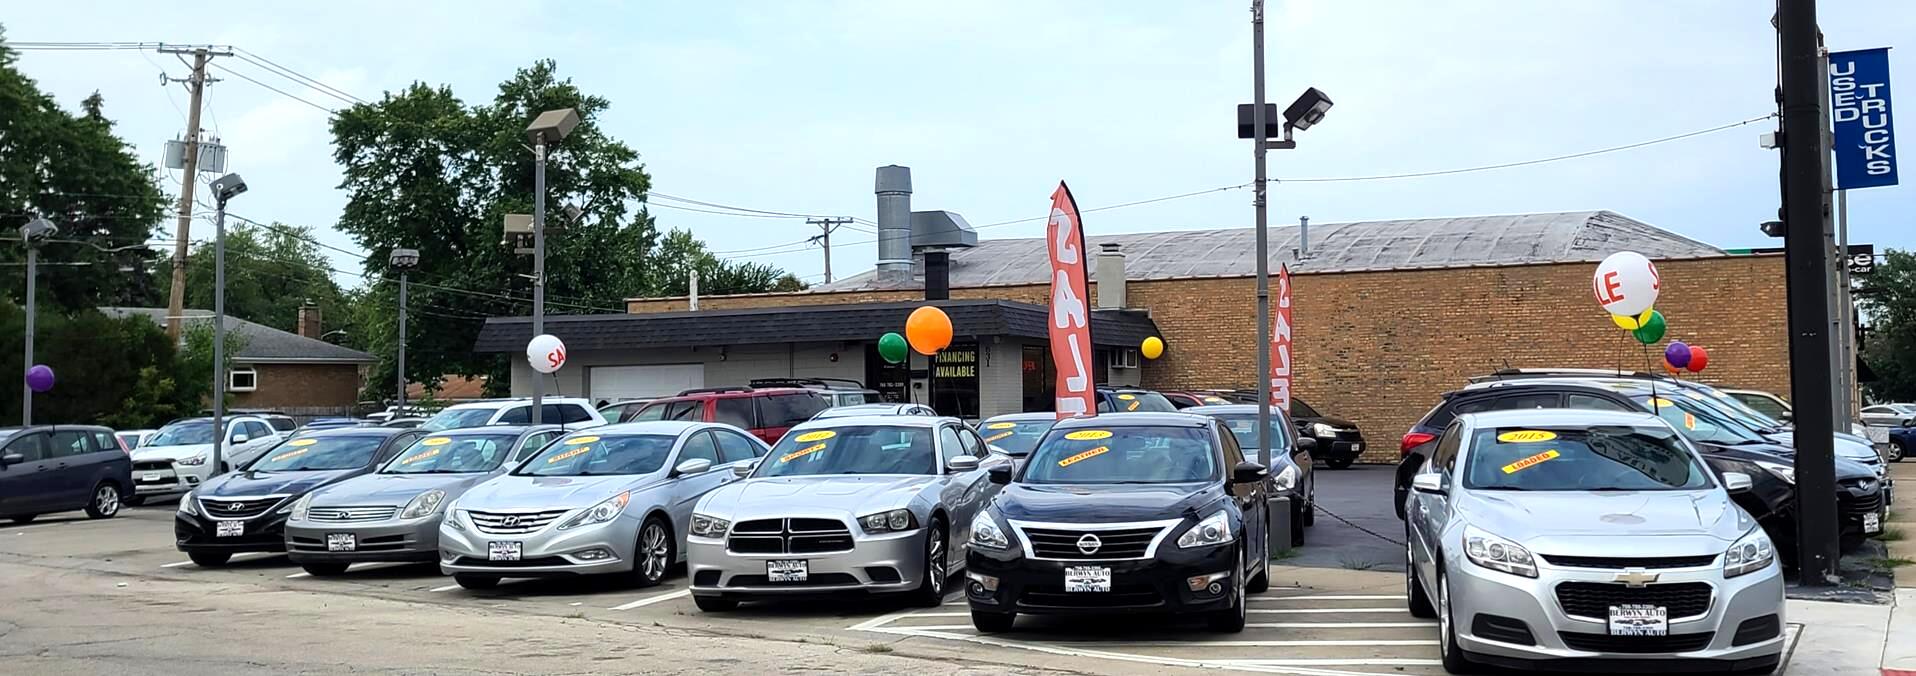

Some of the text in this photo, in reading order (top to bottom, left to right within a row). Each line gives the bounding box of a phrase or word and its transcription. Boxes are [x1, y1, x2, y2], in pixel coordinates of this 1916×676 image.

[1830, 61, 1860, 123] USED
[1859, 82, 1892, 176] TRUCKS
[935, 351, 976, 364] FINANCING
[935, 365, 976, 378] AVAILABLE
[1509, 432, 1545, 441] 2015
[1062, 447, 1105, 465] LEATHER
[1511, 453, 1550, 470] LOADED
[1610, 609, 1666, 617] BERWYN AUTO
